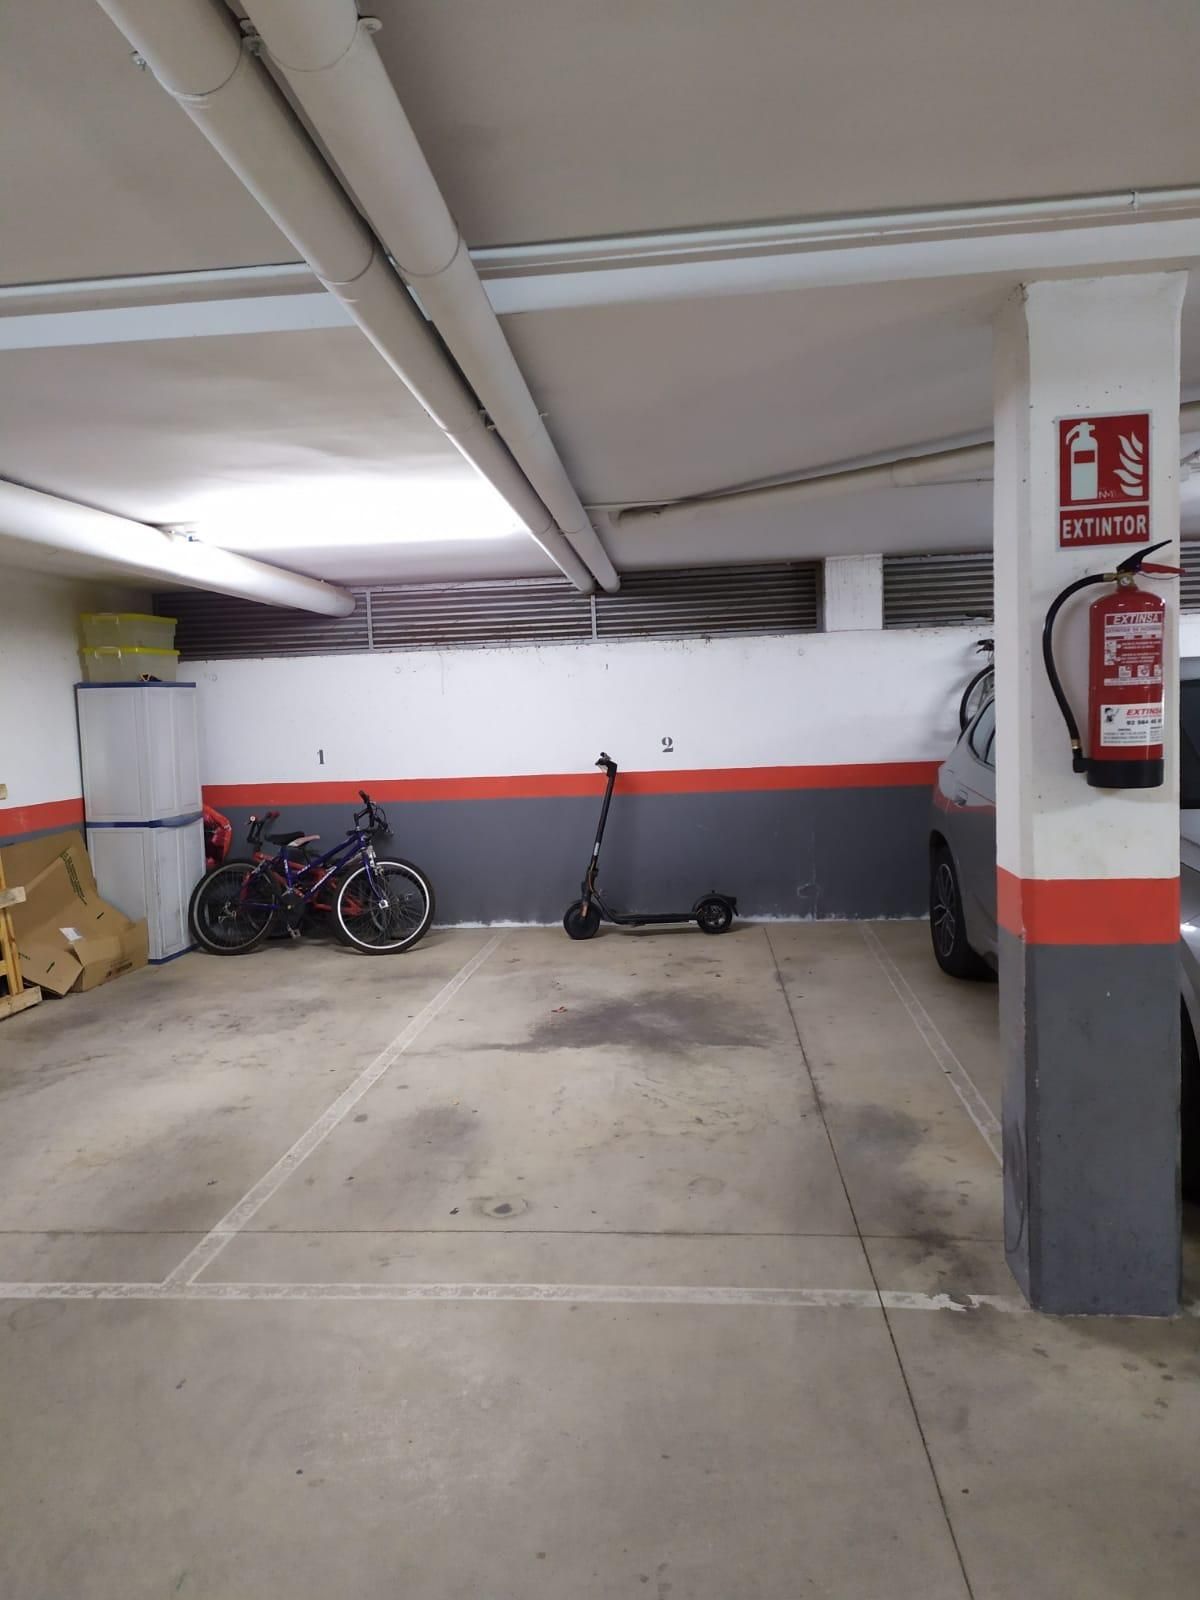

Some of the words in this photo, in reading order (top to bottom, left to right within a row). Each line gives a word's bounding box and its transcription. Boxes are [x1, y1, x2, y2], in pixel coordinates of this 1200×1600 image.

[1062, 514, 1147, 539] EXTINTOR
[1113, 613, 1159, 625] EXTINSA
[661, 736, 674, 753] 2
[316, 749, 325, 765] 1
